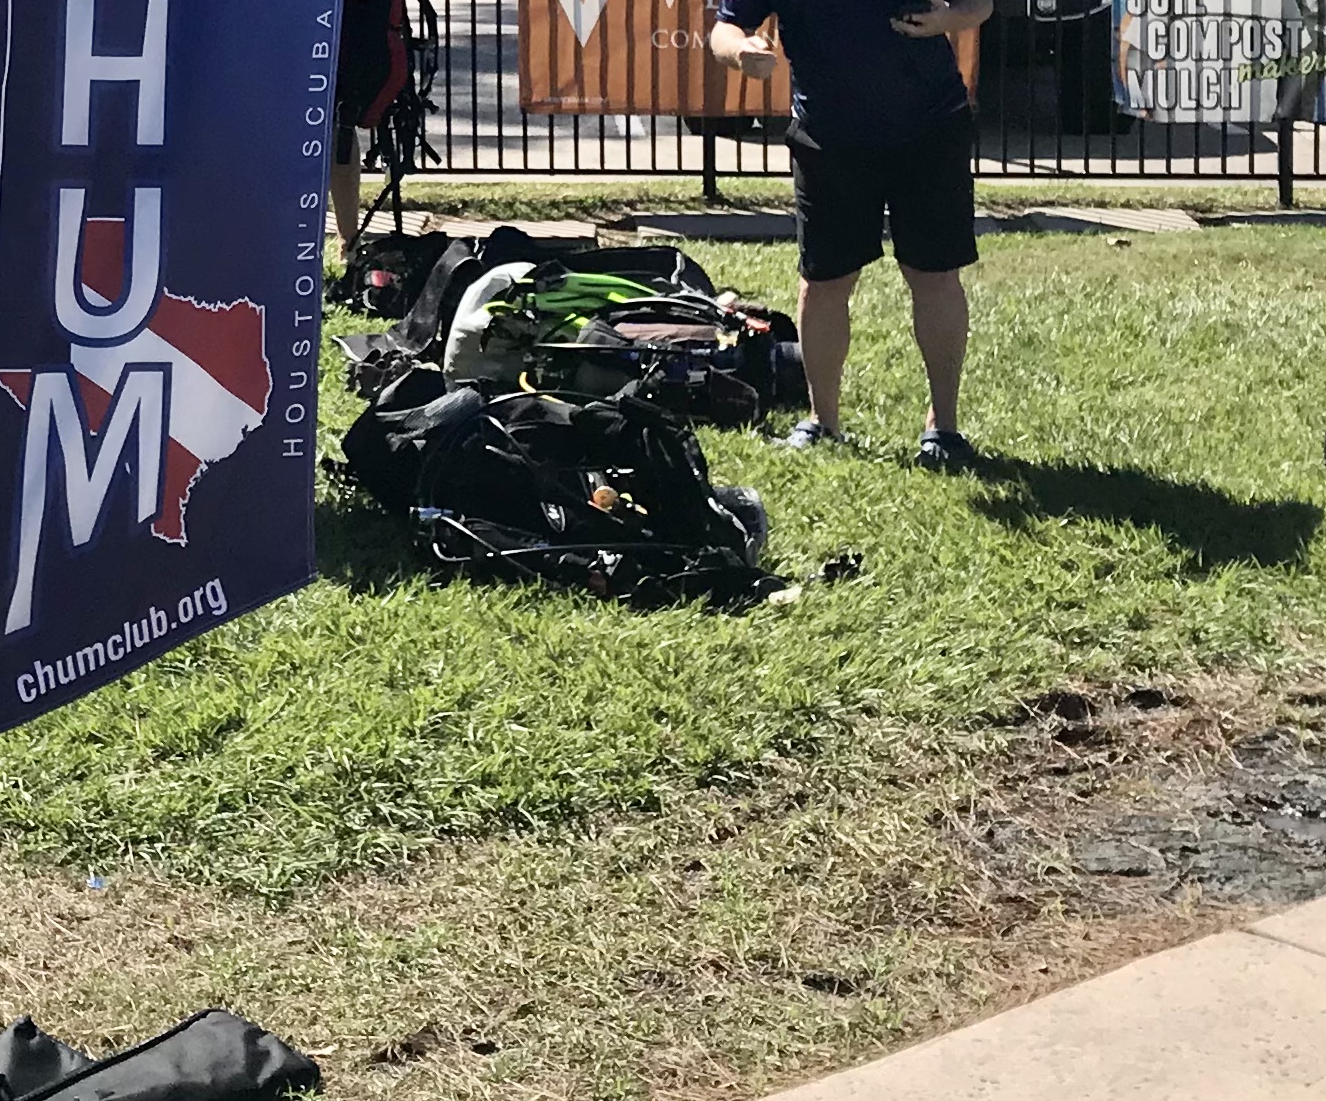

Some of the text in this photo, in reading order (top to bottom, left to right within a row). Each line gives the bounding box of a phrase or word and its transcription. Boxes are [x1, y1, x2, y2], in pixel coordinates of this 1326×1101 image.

[1146, 18, 1303, 61] COMPOST
[1237, 50, 1326, 83] maker
[1127, 68, 1242, 110] MULCH
[282, 192, 319, 457] HOUSTON'S
[302, 8, 333, 157] SCUBA
[16, 577, 229, 702] chumclub.org
